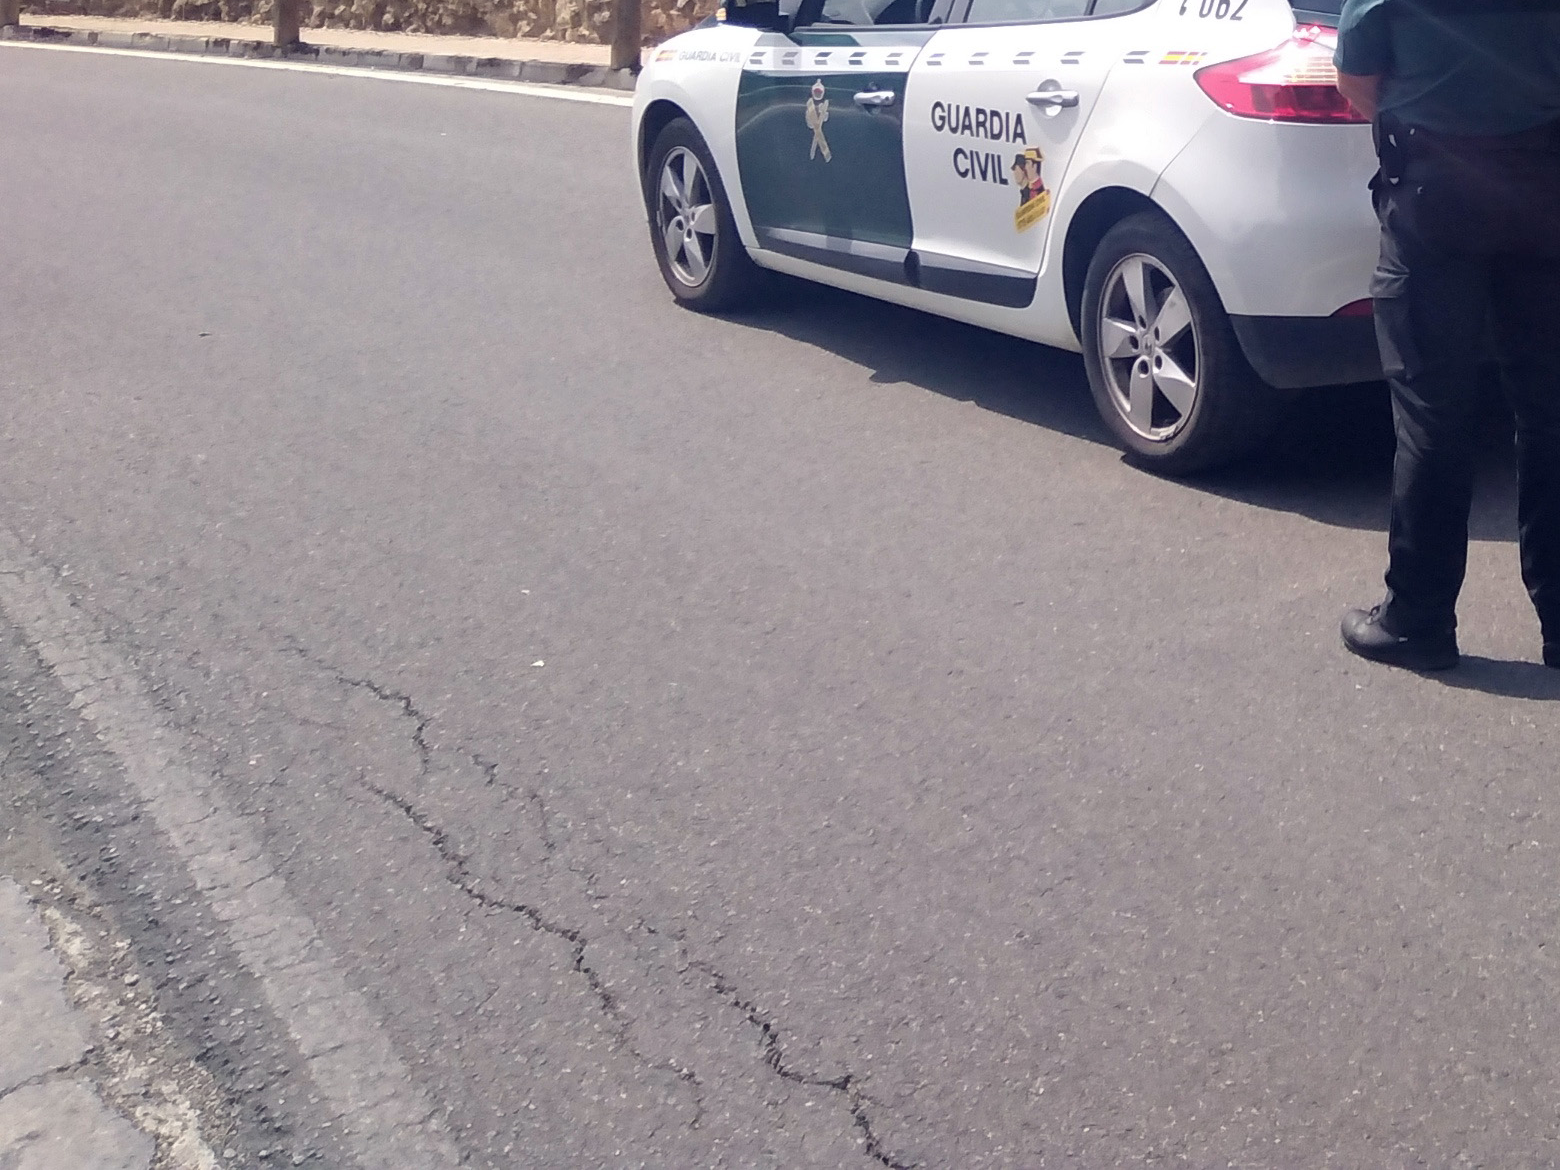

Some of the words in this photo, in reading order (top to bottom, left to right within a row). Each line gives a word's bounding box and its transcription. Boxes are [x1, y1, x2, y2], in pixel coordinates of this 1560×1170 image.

[679, 50, 717, 61] GUARDIA
[719, 51, 740, 62] CIVIL
[931, 100, 1027, 145] GUARDIA
[953, 147, 1009, 185] CIVIL
